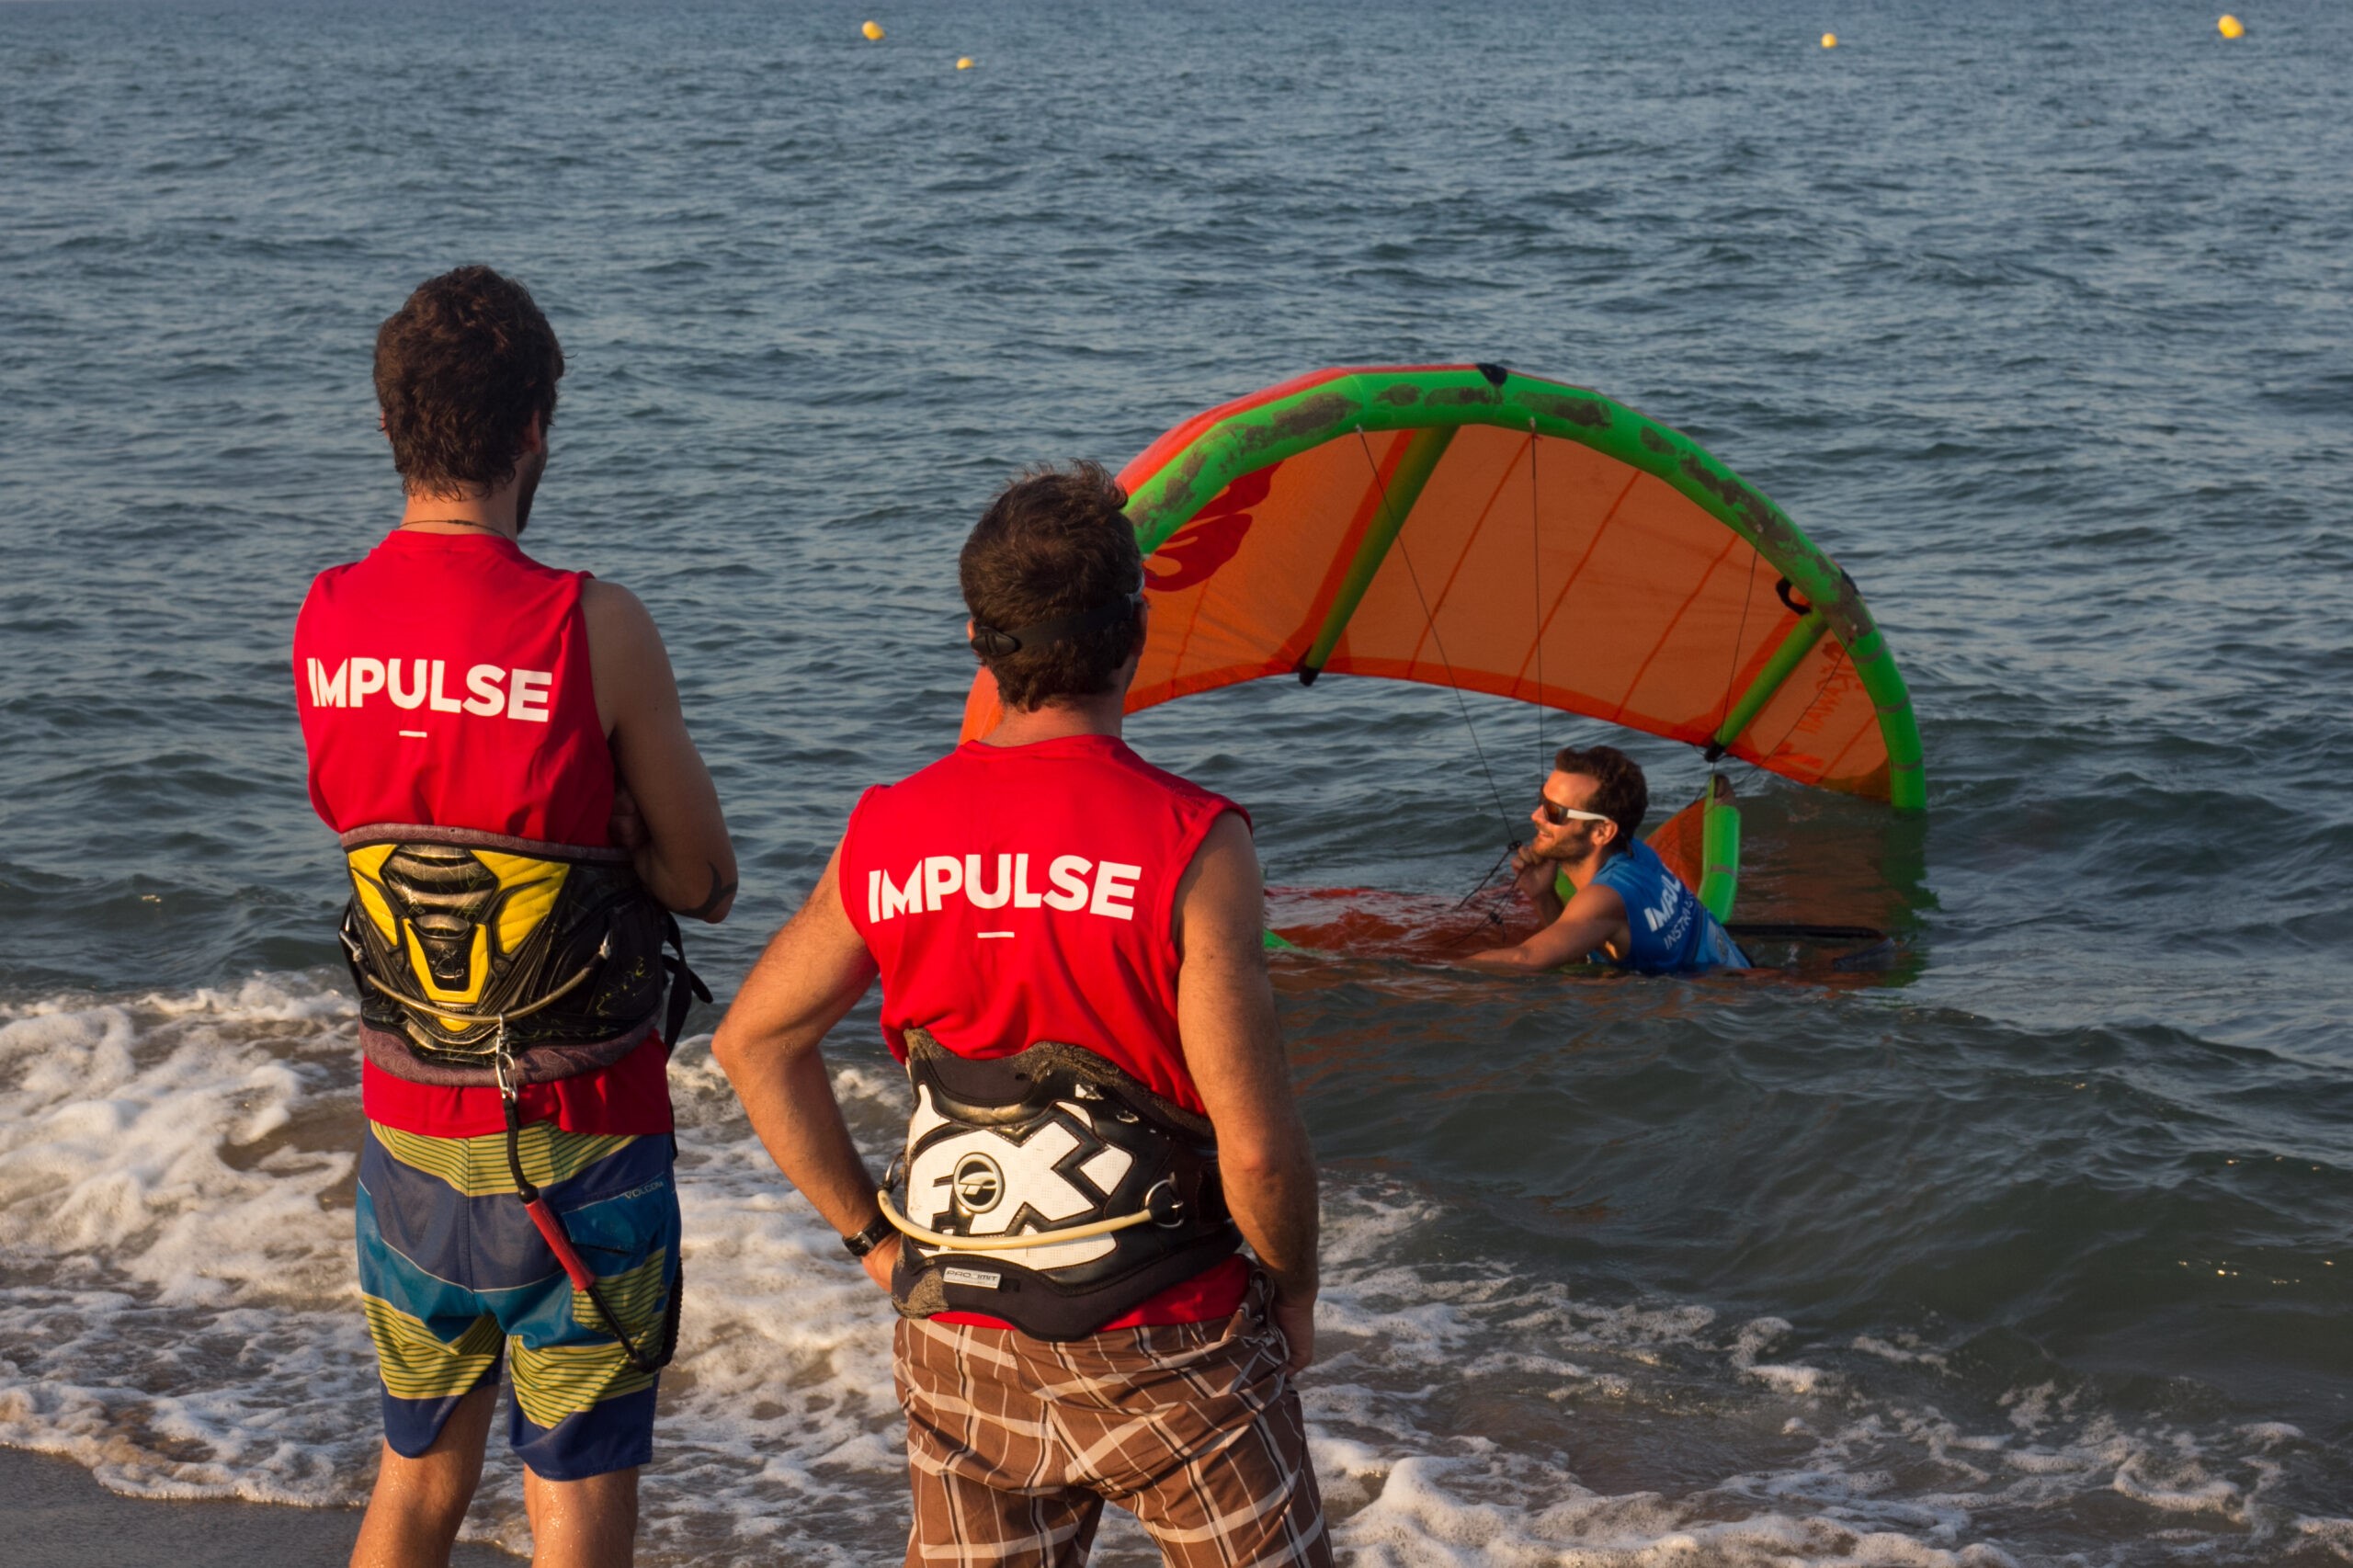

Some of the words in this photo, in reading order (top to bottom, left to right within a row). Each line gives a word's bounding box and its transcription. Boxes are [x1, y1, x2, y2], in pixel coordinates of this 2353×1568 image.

[307, 657, 552, 722] IMPULSE
[869, 853, 1142, 924] IMPULSE
[946, 1269, 998, 1280] PROIMIT
